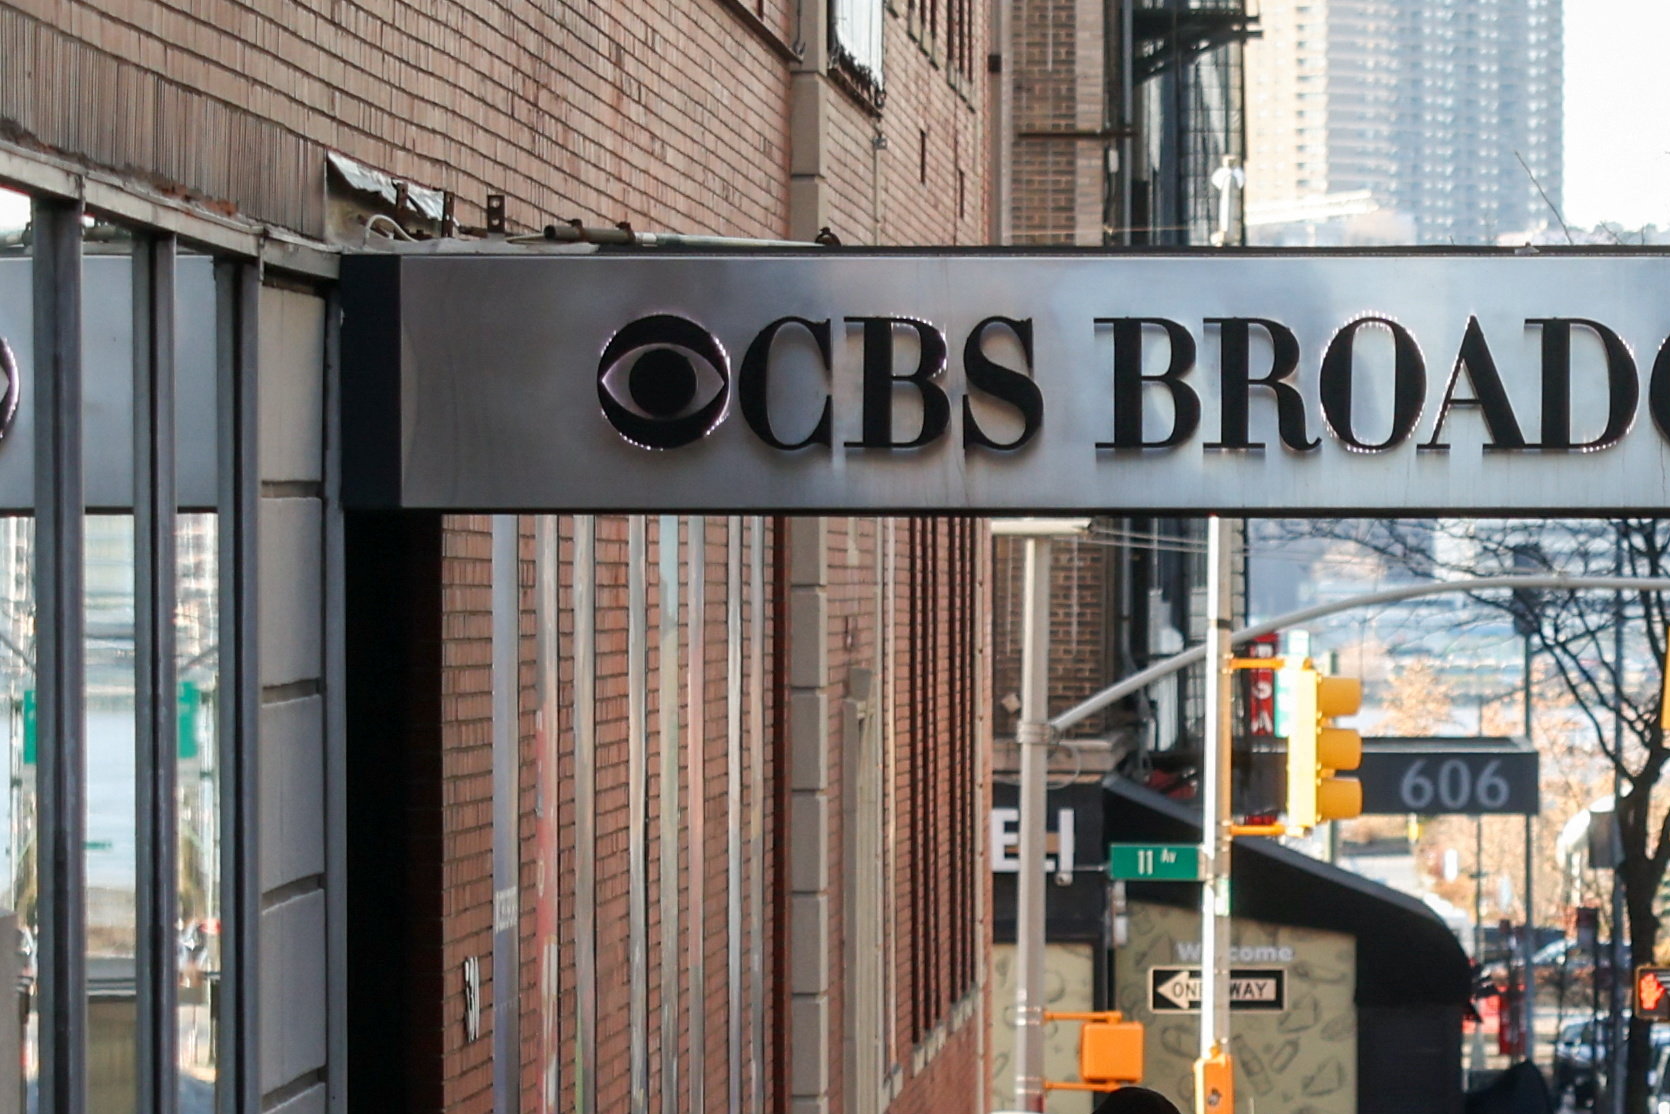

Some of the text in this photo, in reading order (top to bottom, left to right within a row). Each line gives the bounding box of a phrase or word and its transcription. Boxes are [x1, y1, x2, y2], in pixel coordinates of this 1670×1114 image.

[739, 314, 1044, 452] CBS
[1401, 758, 1510, 809] 606
[1137, 848, 1177, 875] 11 Av
[1177, 943, 1295, 962] Wcome
